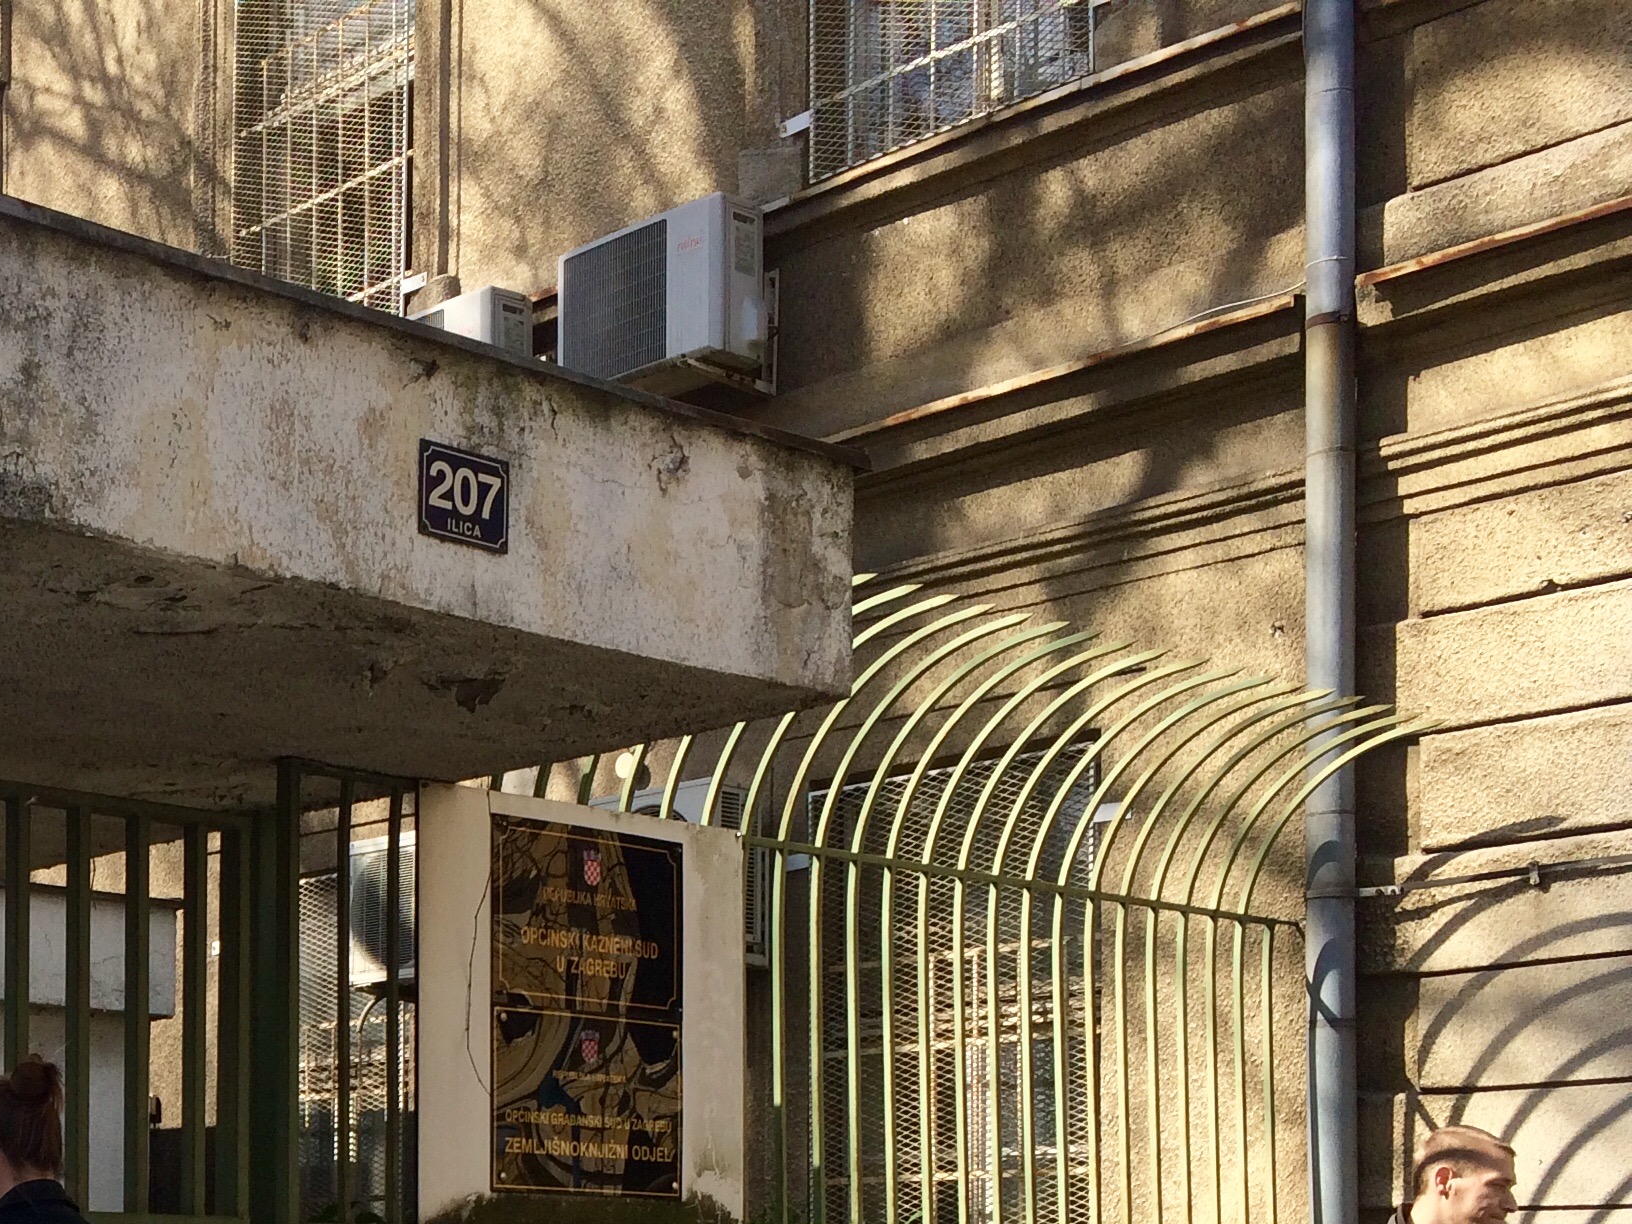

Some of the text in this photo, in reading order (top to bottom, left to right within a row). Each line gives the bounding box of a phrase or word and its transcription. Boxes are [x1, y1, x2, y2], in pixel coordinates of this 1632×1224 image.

[428, 459, 502, 521] 207
[447, 517, 482, 538] ILICA
[634, 940, 659, 960] SUD
[556, 955, 627, 980] U ZAGREBU
[504, 1136, 673, 1163] ZEMLJIŠNOKNJIŽNI ODJEL
